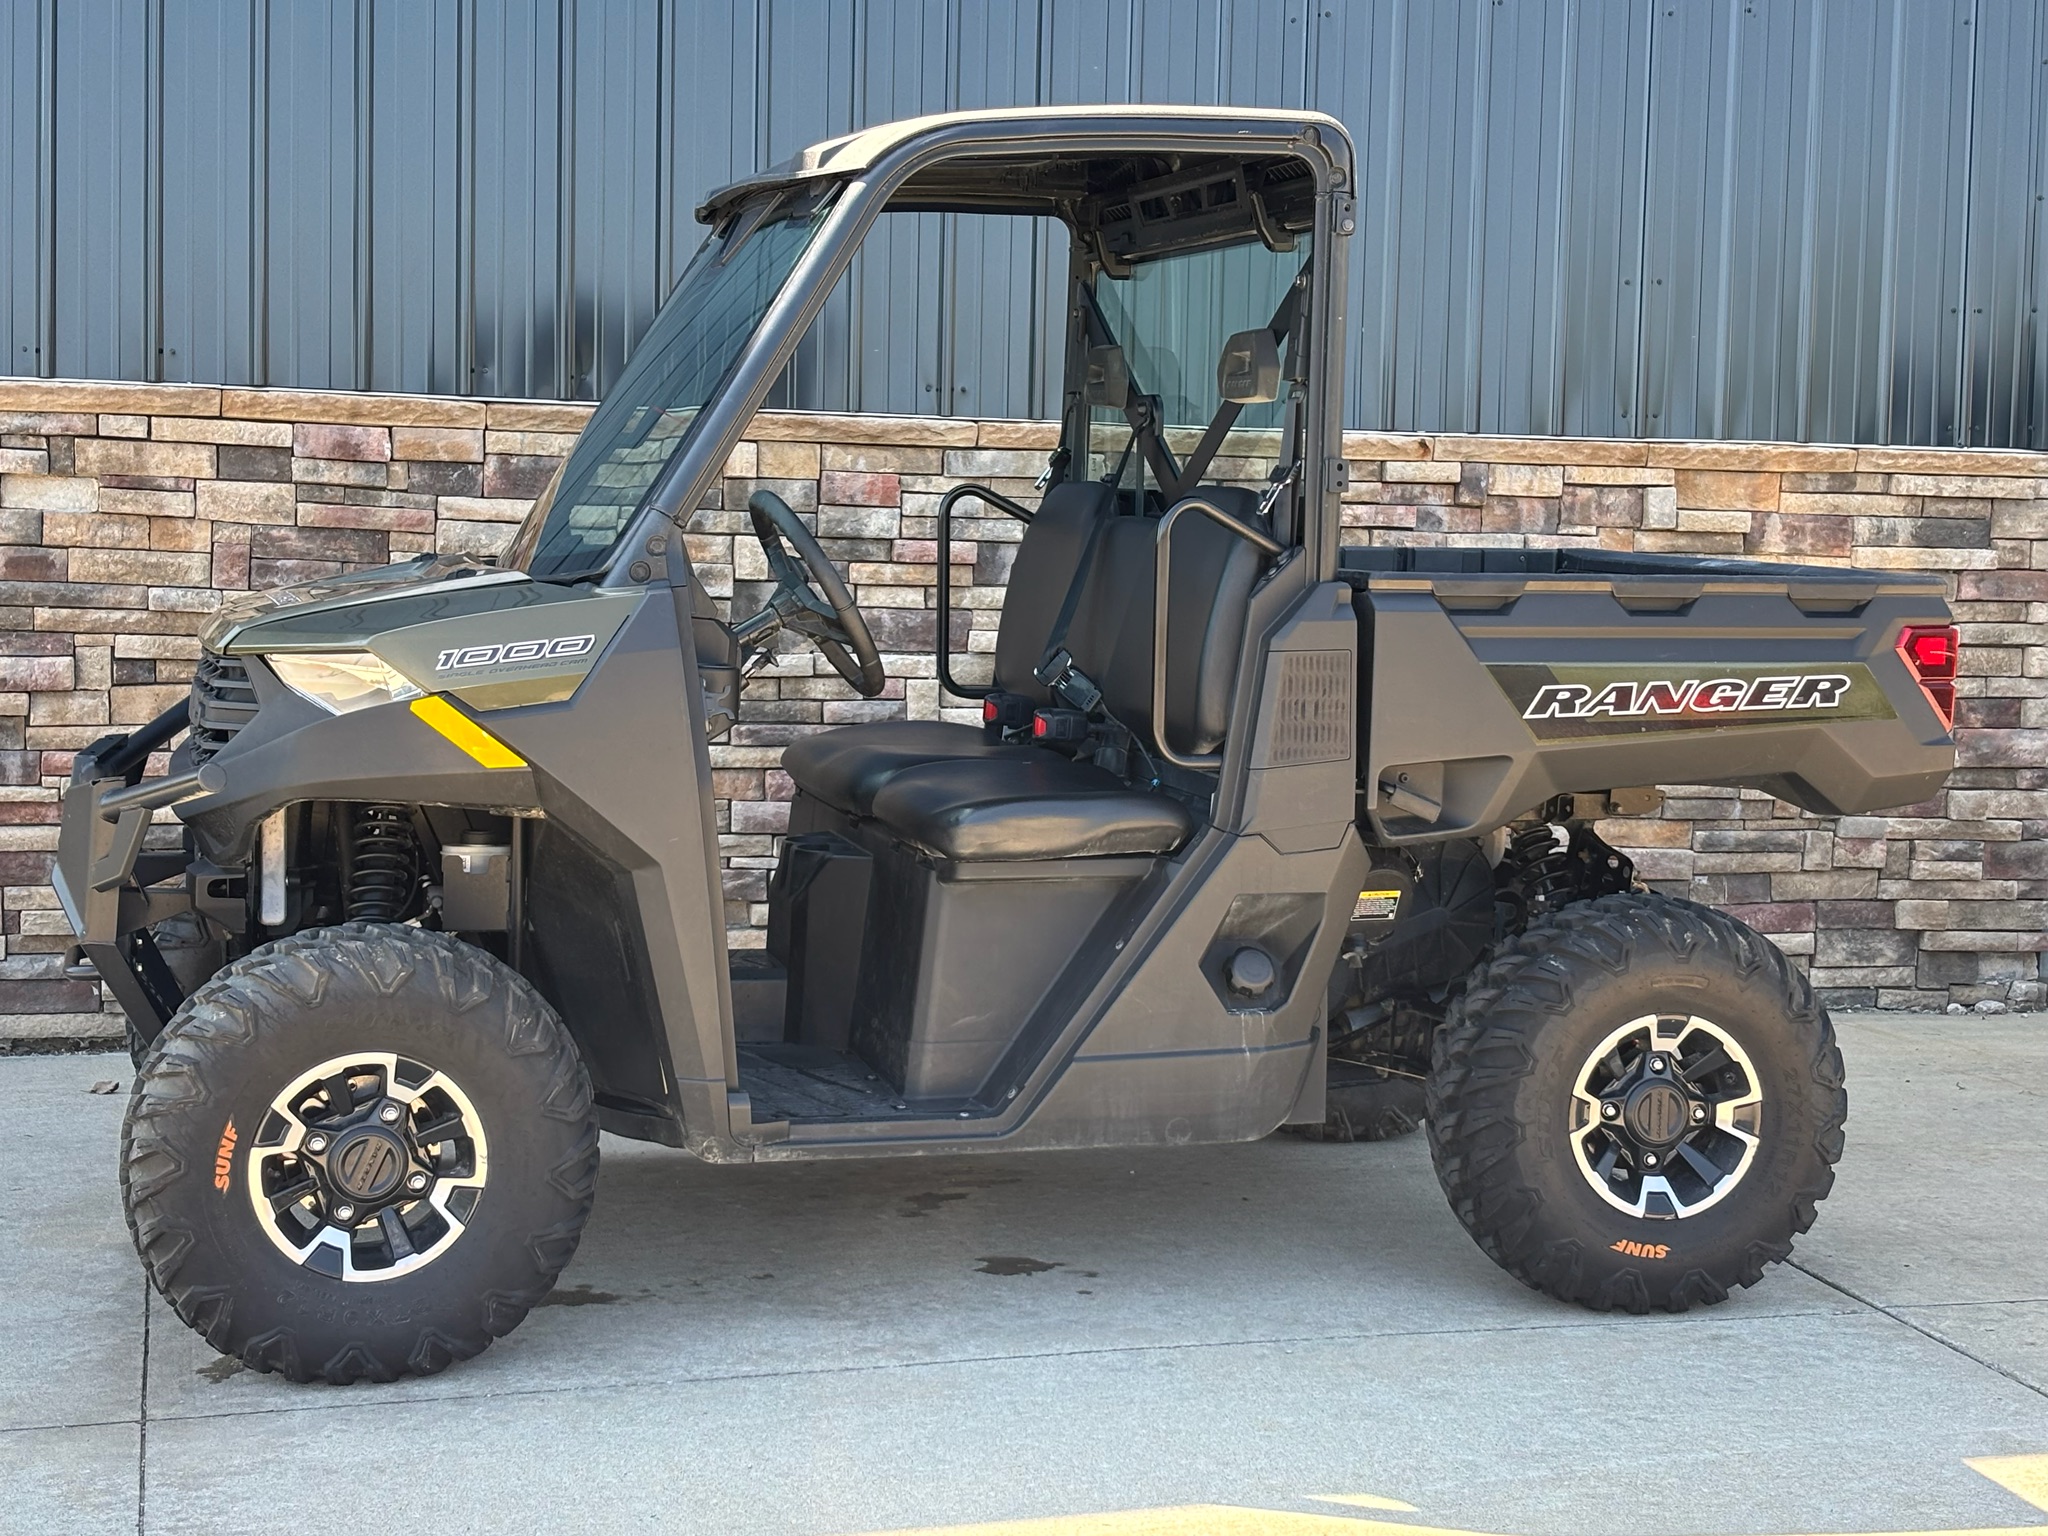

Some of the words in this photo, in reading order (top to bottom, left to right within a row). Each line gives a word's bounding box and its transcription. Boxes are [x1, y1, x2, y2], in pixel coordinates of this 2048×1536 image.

[435, 634, 596, 670] 1000
[438, 669, 485, 679] SINGLE
[489, 661, 557, 674] OVERHEAD
[1522, 674, 1851, 719] RANGER
[214, 1119, 238, 1193] SUNF
[1609, 1239, 1672, 1259] SUNF
